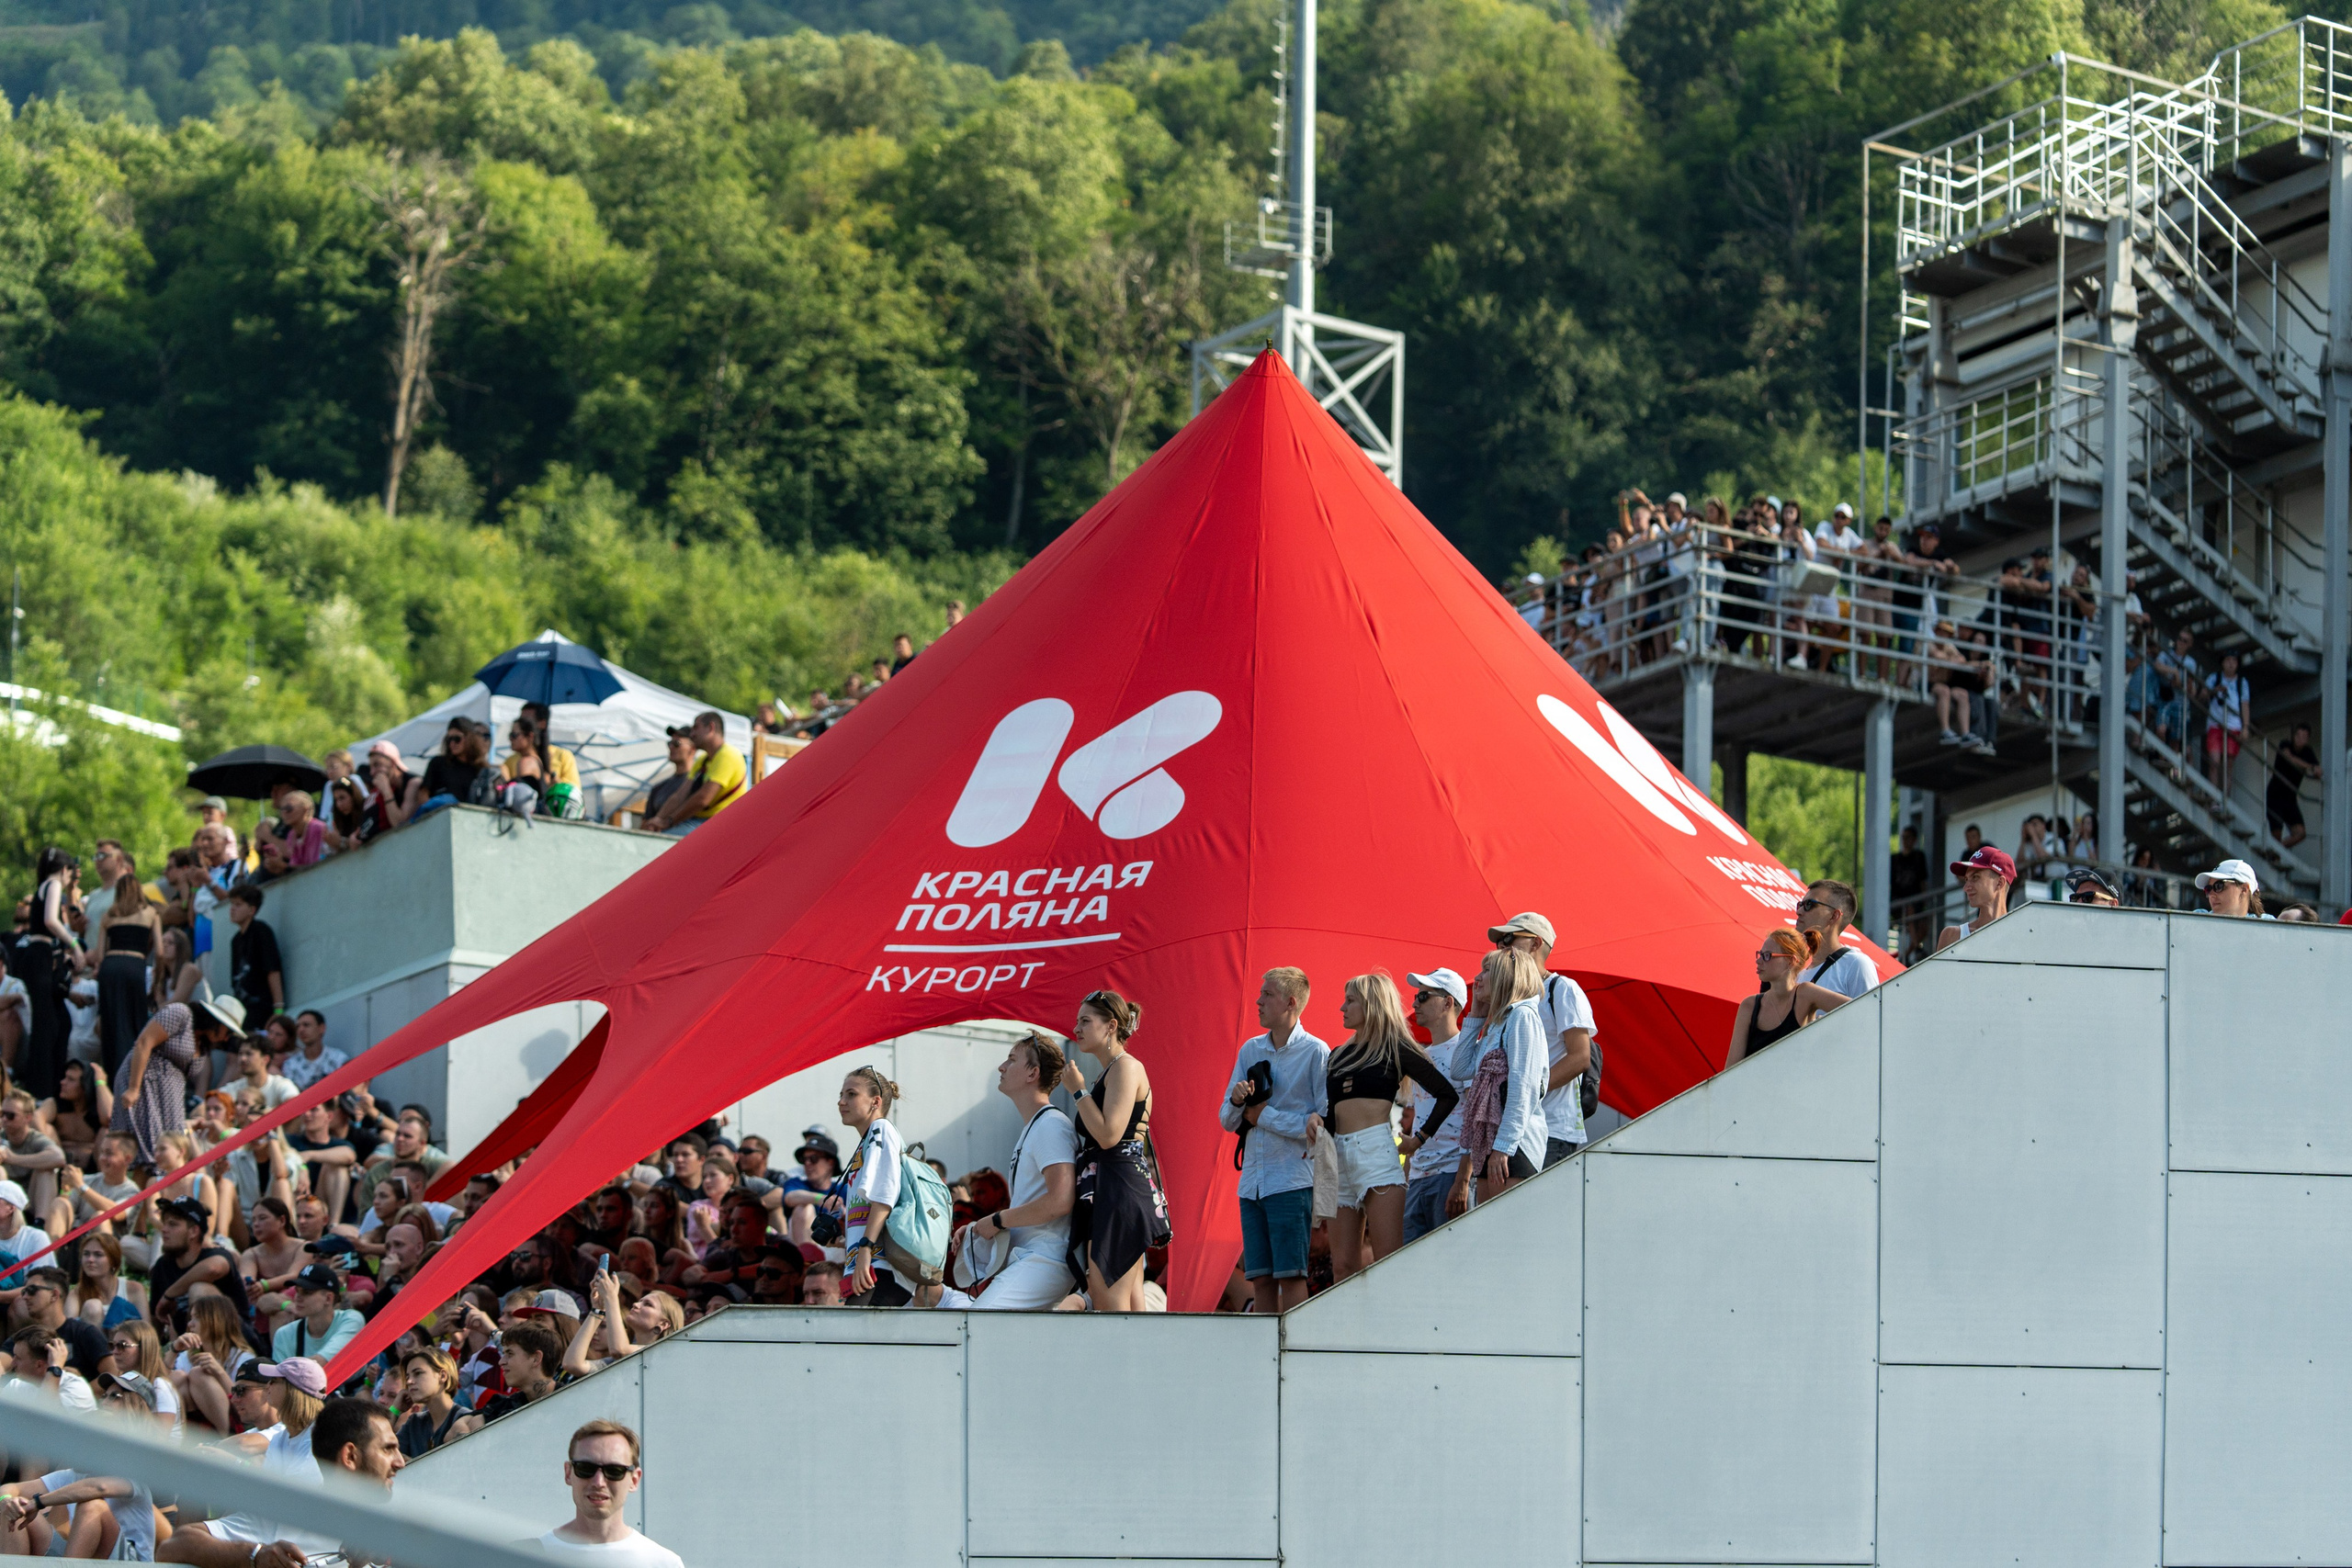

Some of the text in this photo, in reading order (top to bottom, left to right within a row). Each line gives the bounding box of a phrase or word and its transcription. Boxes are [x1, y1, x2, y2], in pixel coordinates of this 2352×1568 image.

[912, 861, 1154, 899] КРАСНАЯ
[896, 896, 1108, 931] ПОЛЯНА
[866, 963, 1046, 993] КУРОРТ
